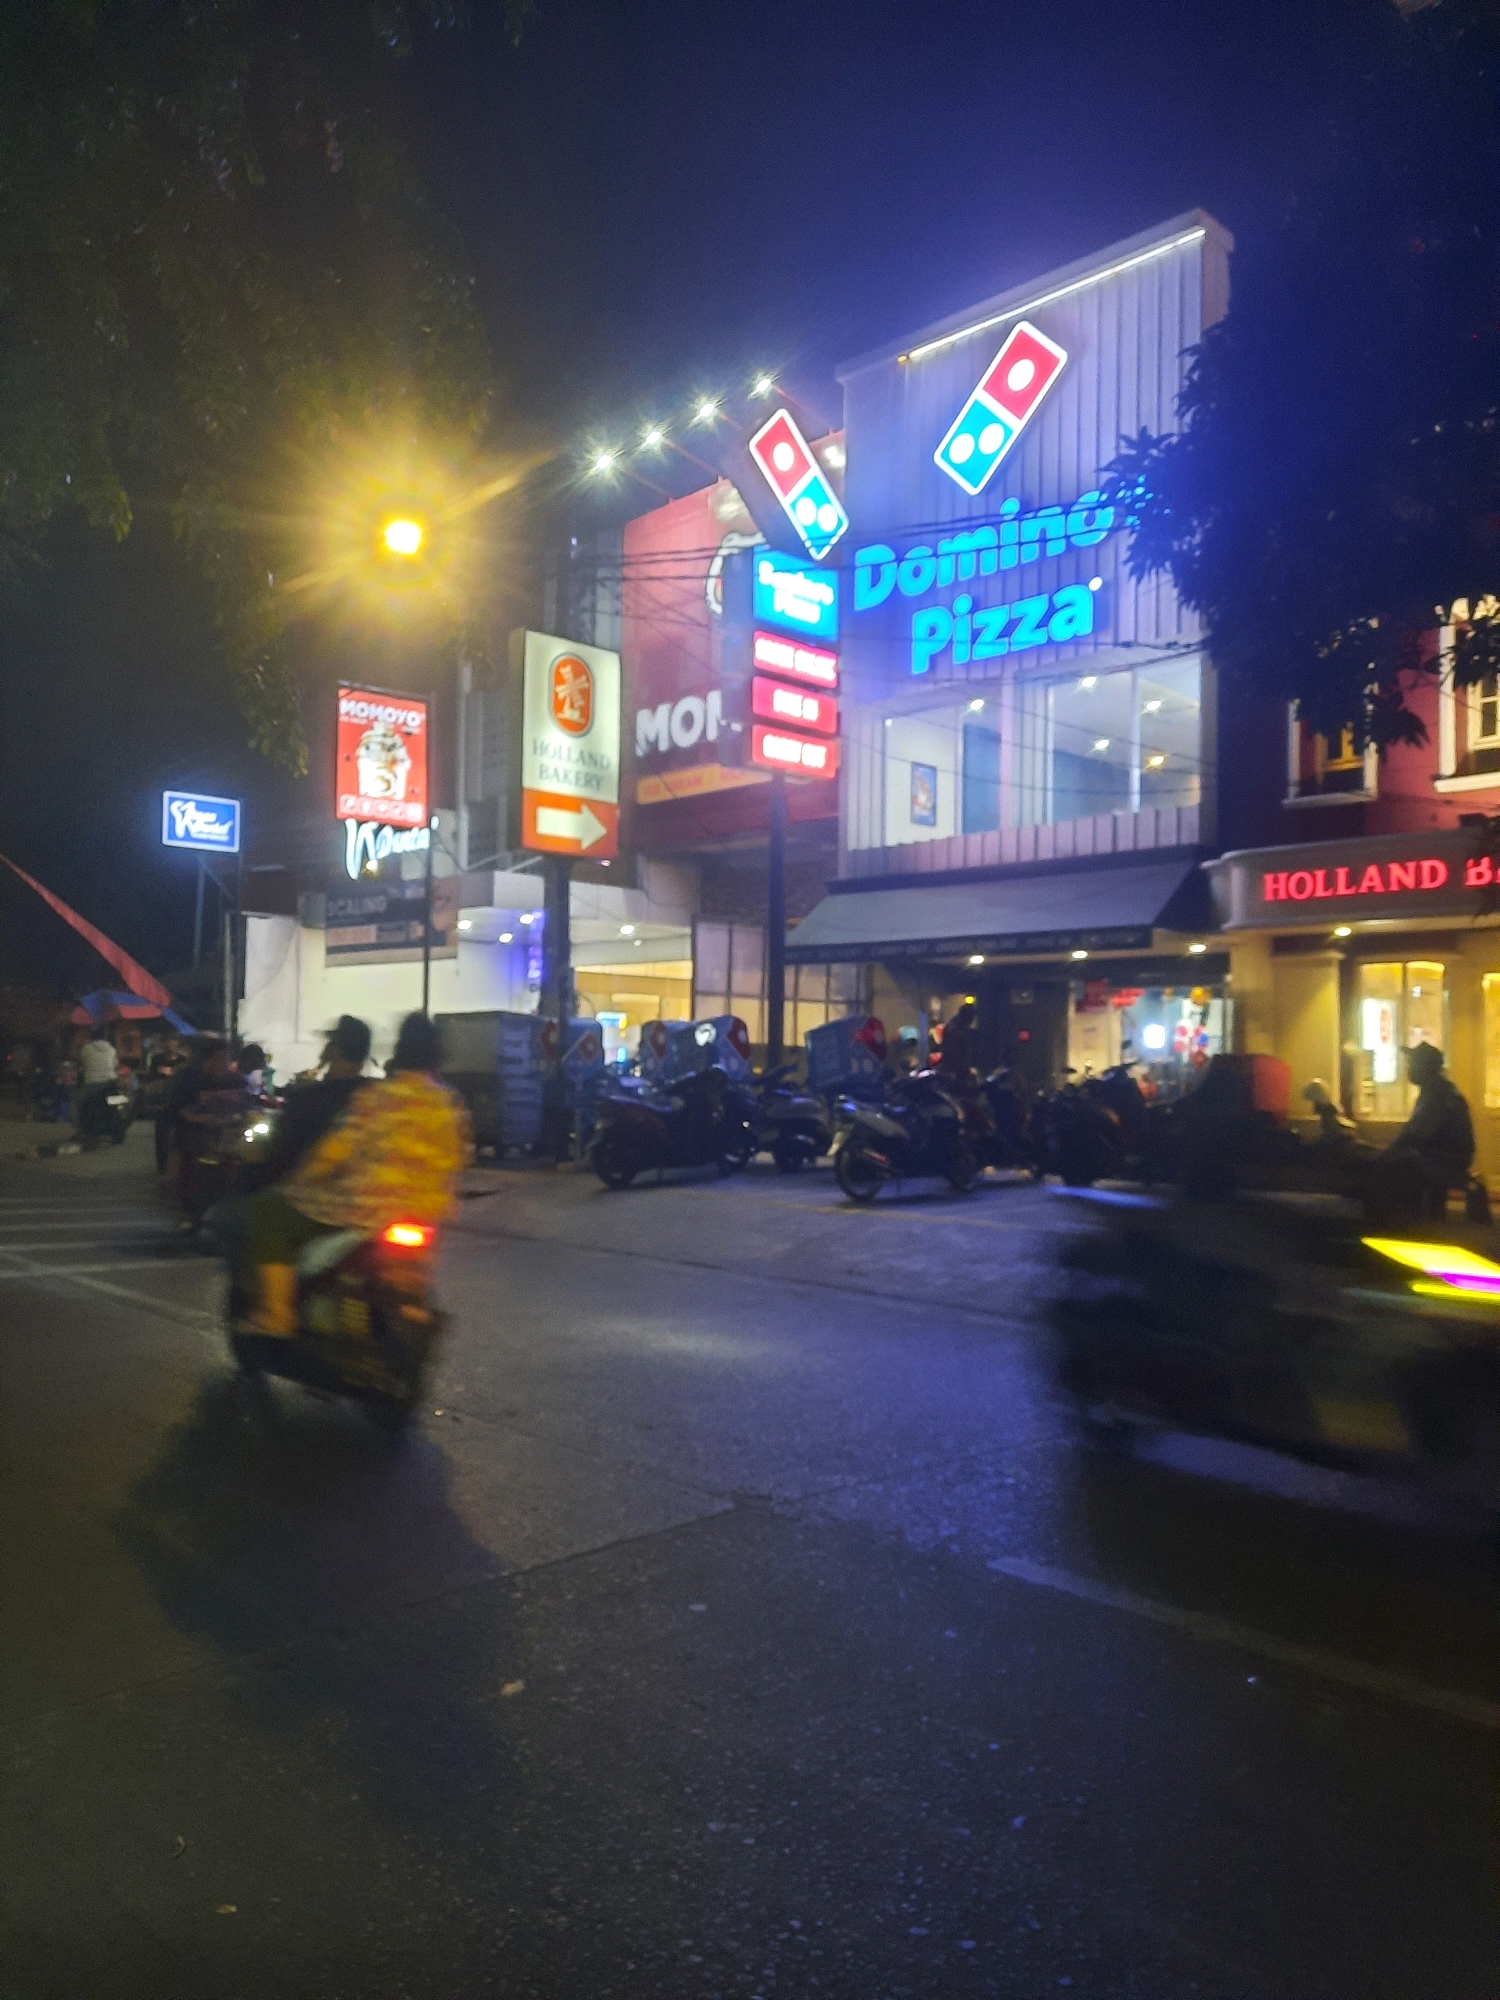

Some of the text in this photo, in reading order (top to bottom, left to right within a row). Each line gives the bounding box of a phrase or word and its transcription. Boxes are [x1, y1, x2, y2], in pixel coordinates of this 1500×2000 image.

[853, 474, 1156, 612] Domino
[911, 583, 1094, 676] Pizza
[533, 739, 611, 769] HOLLAND
[539, 763, 603, 790] BAKERY
[1263, 856, 1500, 902] HOLLAND B
